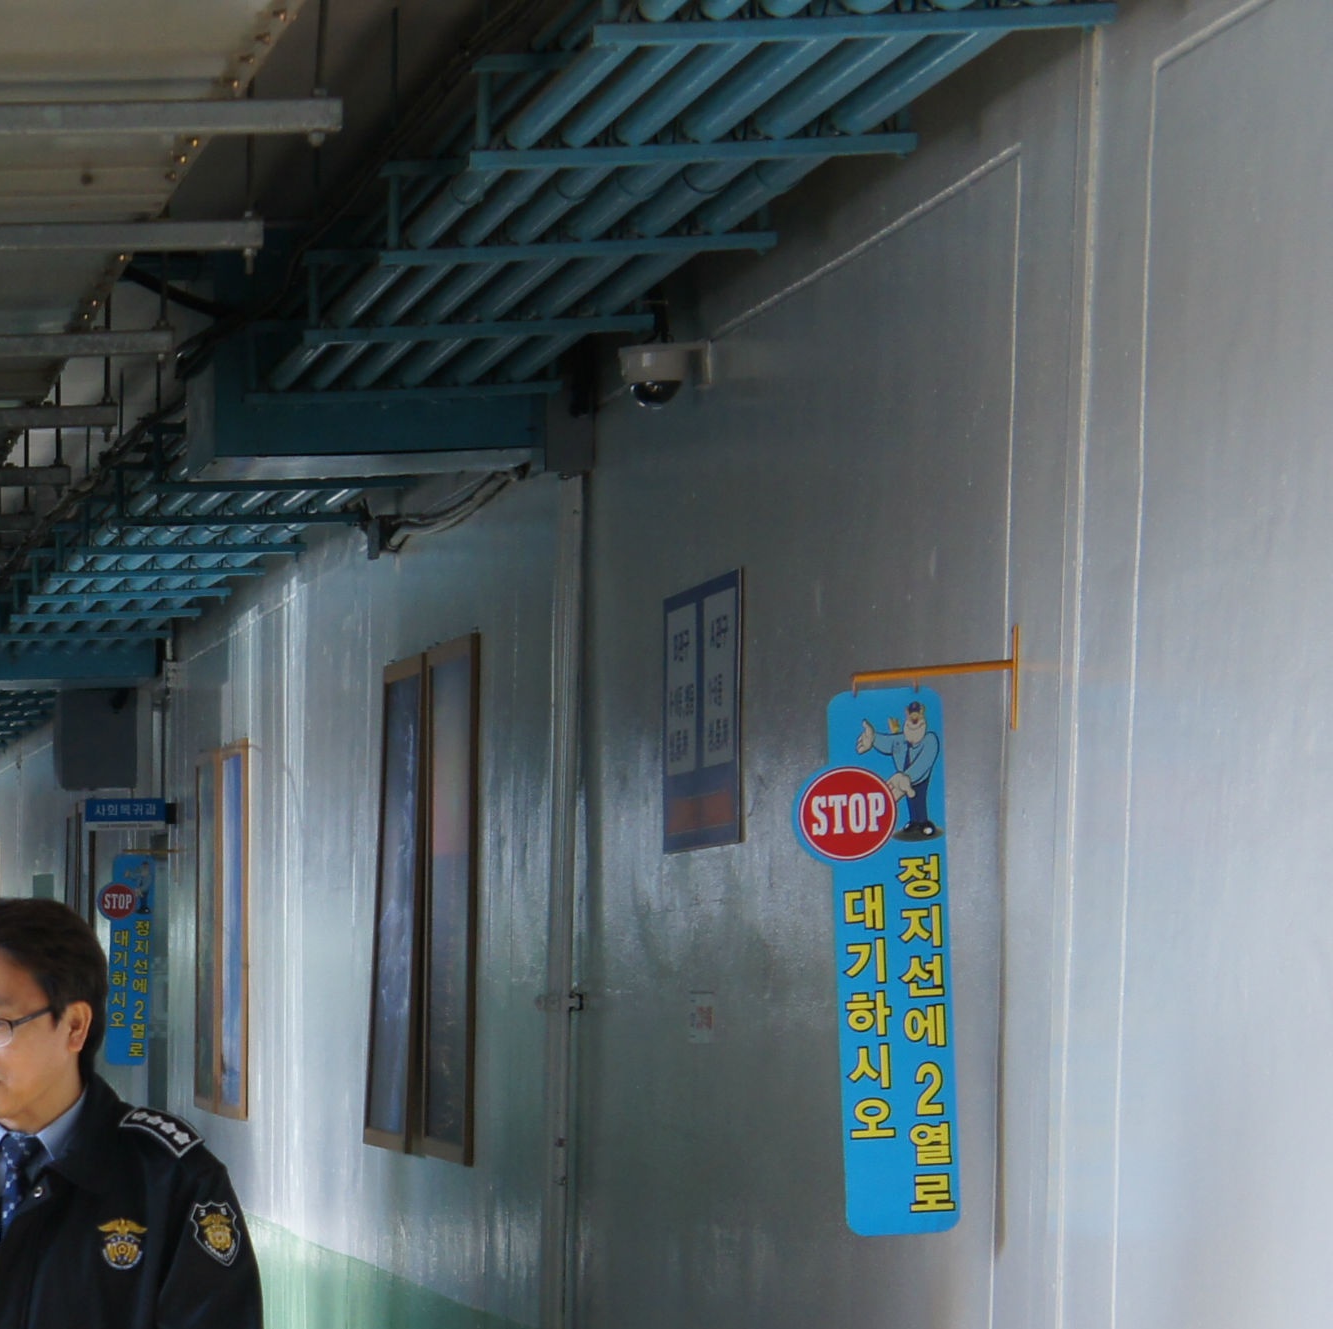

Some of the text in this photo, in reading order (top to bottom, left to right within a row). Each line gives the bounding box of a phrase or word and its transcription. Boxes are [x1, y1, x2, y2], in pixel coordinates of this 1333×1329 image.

[810, 790, 886, 837] STOP
[104, 893, 133, 909] STOP
[109, 929, 130, 1028] 대기하시오
[128, 920, 151, 1058] 정지선에 2열로
[842, 885, 895, 1141] 대기하시오
[896, 853, 956, 1214] 정지선에 2열로
